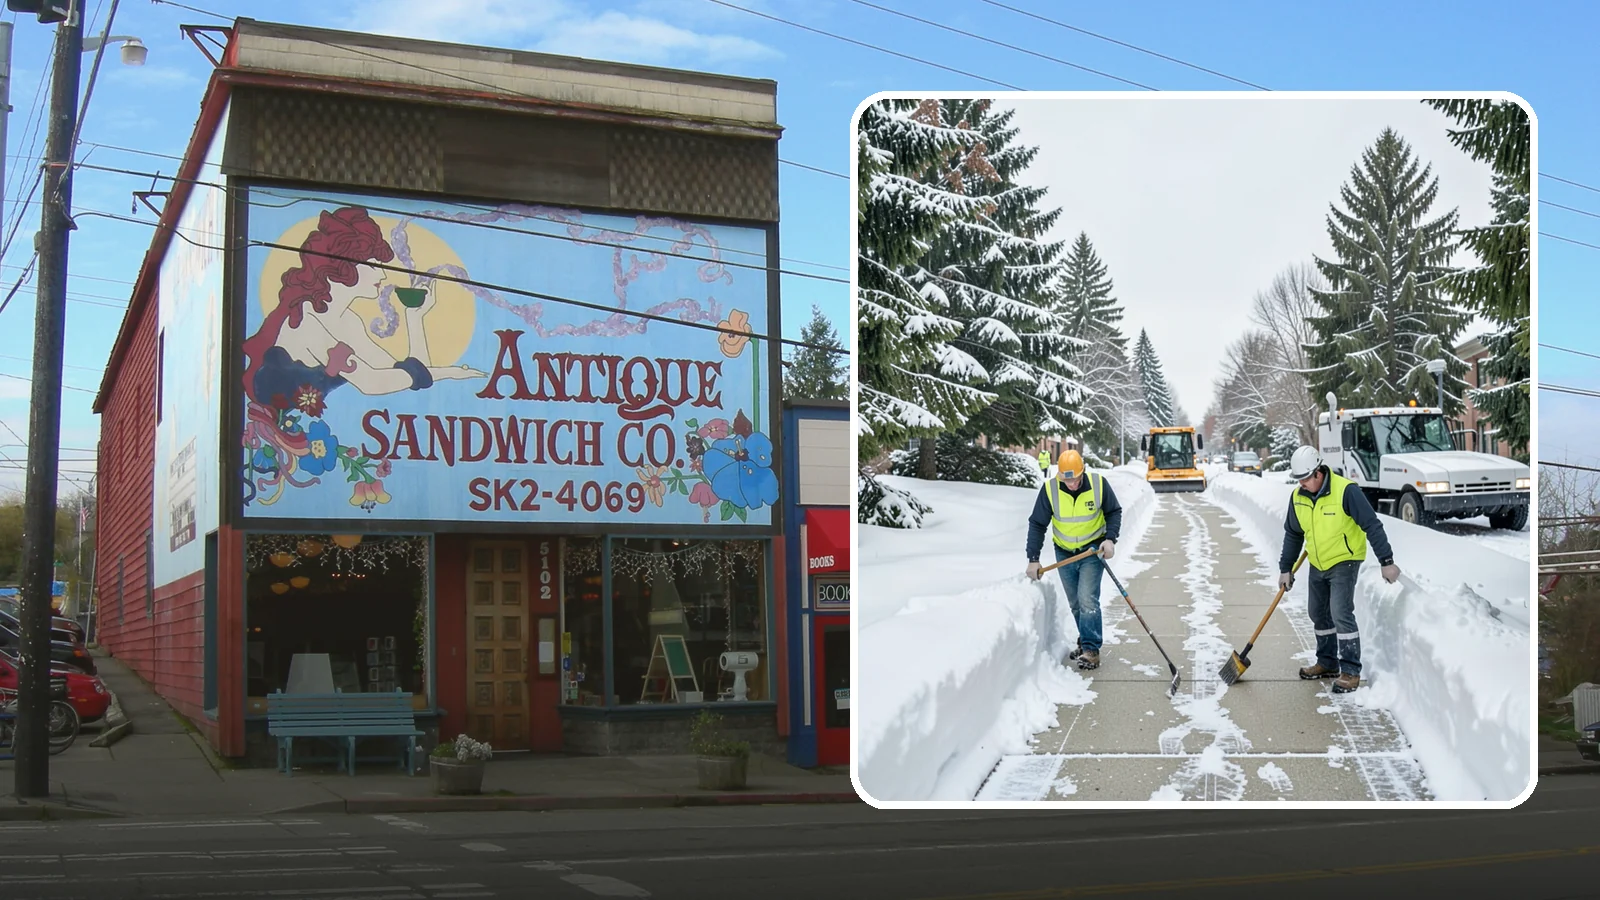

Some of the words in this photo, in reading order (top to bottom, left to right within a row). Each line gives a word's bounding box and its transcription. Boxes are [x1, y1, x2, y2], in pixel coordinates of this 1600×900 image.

[476, 329, 723, 420] ANTIQUE
[361, 409, 604, 467] SANDWICH
[617, 422, 684, 469] CO.
[468, 478, 645, 512] SK2-4069
[540, 542, 551, 599] 5102
[809, 555, 835, 569] BOOKS
